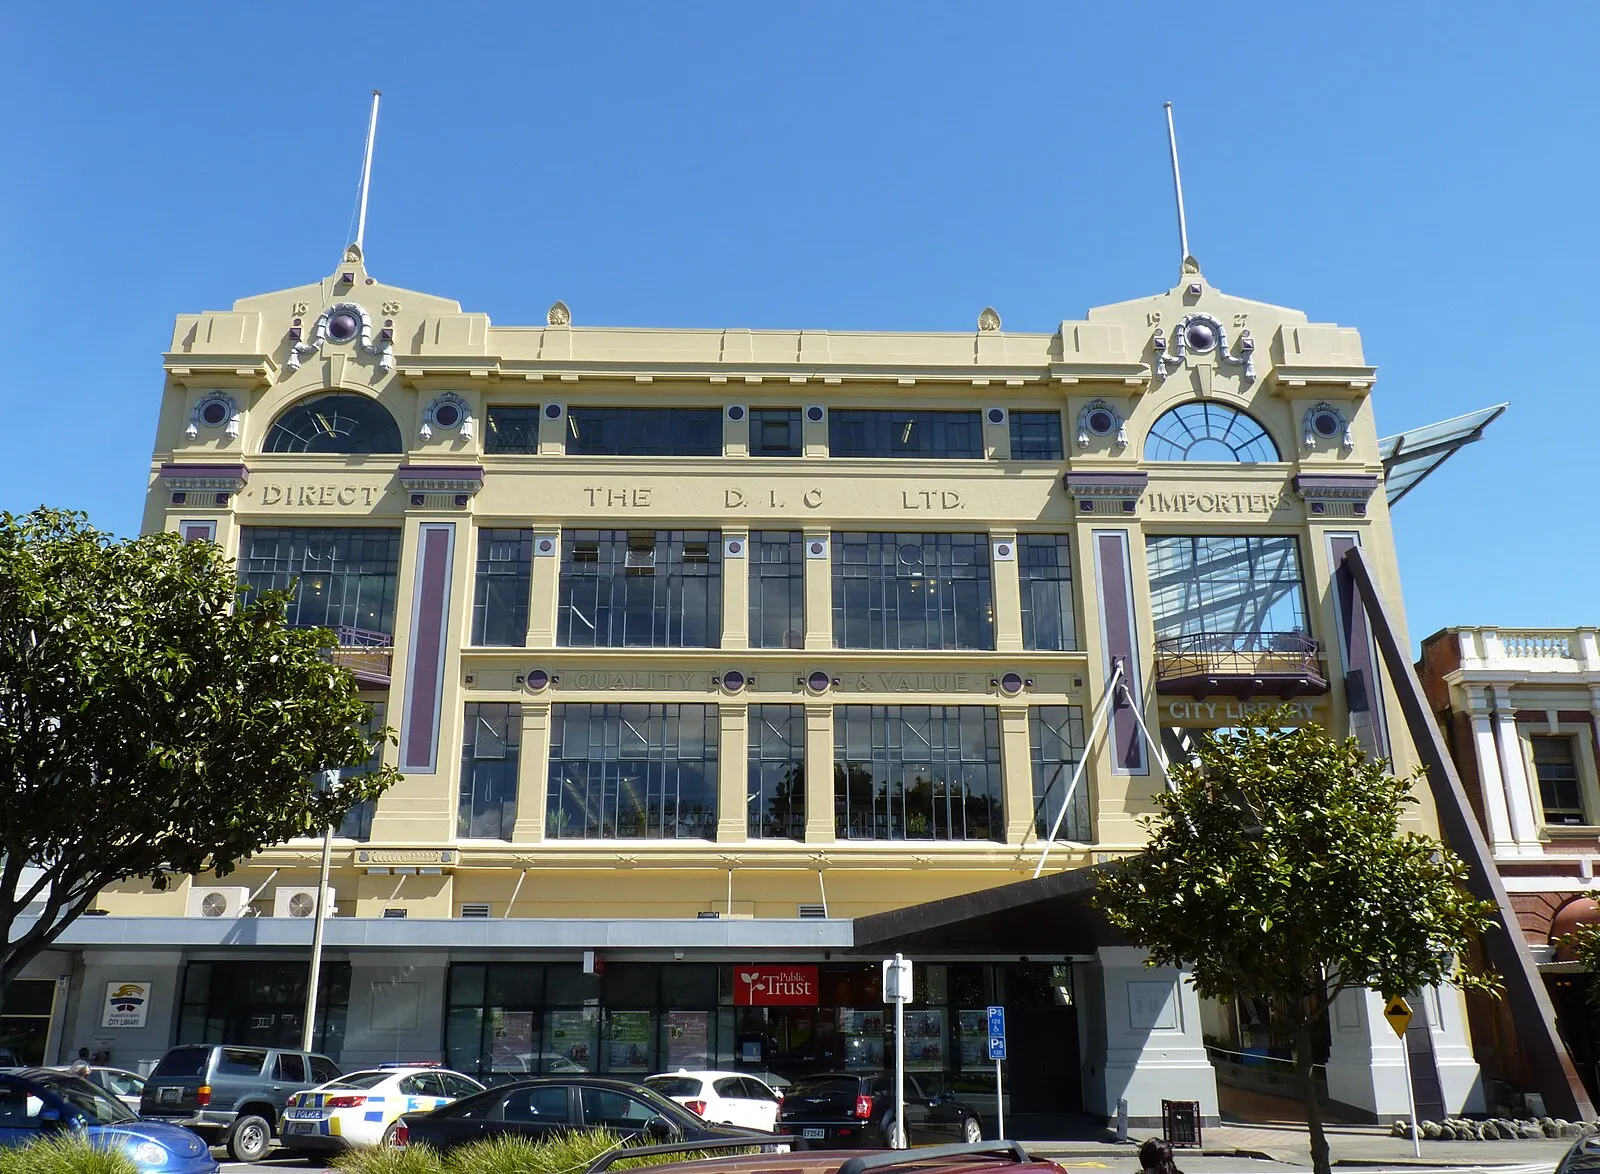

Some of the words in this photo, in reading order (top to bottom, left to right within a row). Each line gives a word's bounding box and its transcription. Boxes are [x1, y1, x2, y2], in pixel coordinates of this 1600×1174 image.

[1146, 311, 1161, 328] 19
[260, 483, 379, 507] DIRECT
[583, 486, 653, 508] THE
[902, 489, 965, 511] LTD.
[1148, 490, 1293, 514] IMPORTERS
[574, 672, 697, 690] QUALITY
[855, 673, 875, 692] &
[878, 673, 969, 692] VALUE
[1169, 701, 1217, 719] CITY
[762, 975, 812, 995] Trust
[780, 972, 806, 982] Public
[296, 1110, 321, 1119] POLICE
